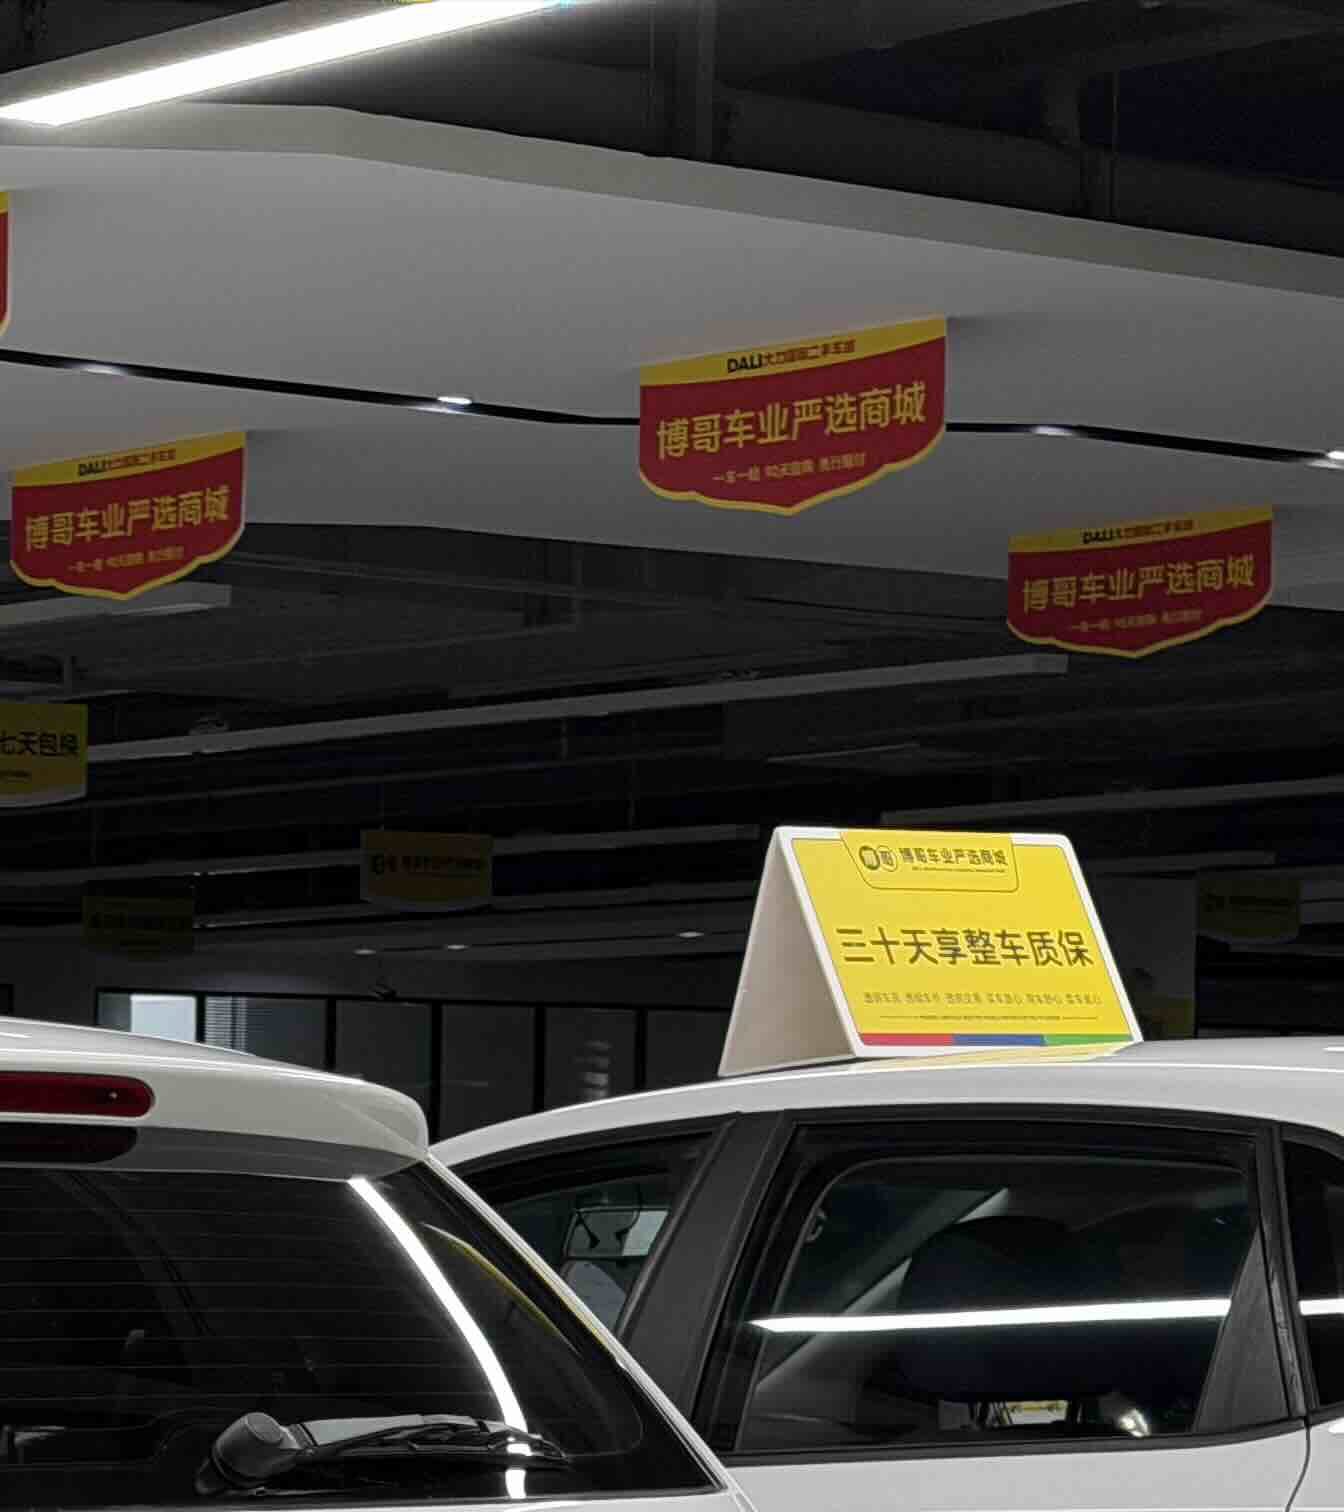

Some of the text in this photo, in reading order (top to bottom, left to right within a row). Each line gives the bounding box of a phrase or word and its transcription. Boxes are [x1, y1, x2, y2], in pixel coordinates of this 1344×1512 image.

[656, 381, 927, 459] 博哥车业严选商城
[25, 485, 230, 552] 博哥车业严选商城
[1023, 554, 1255, 613] 博哥车业严选商城
[836, 926, 1095, 967] 三十天享整车质保
